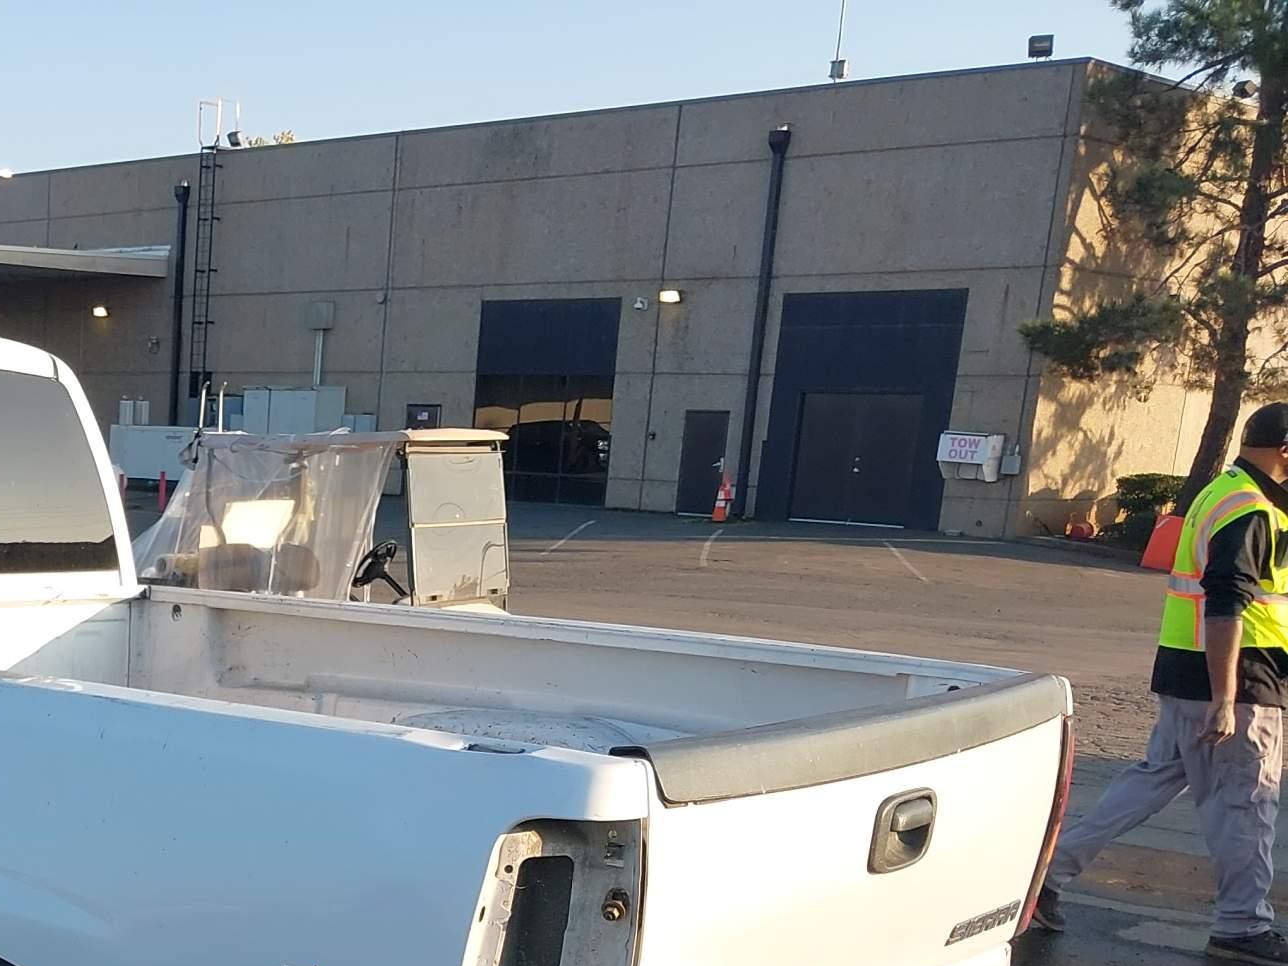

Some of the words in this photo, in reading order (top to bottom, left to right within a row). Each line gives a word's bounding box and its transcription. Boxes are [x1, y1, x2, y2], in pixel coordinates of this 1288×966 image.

[950, 437, 980, 449] TOW
[948, 449, 977, 460] OUT
[944, 899, 1021, 947] SIERRA
